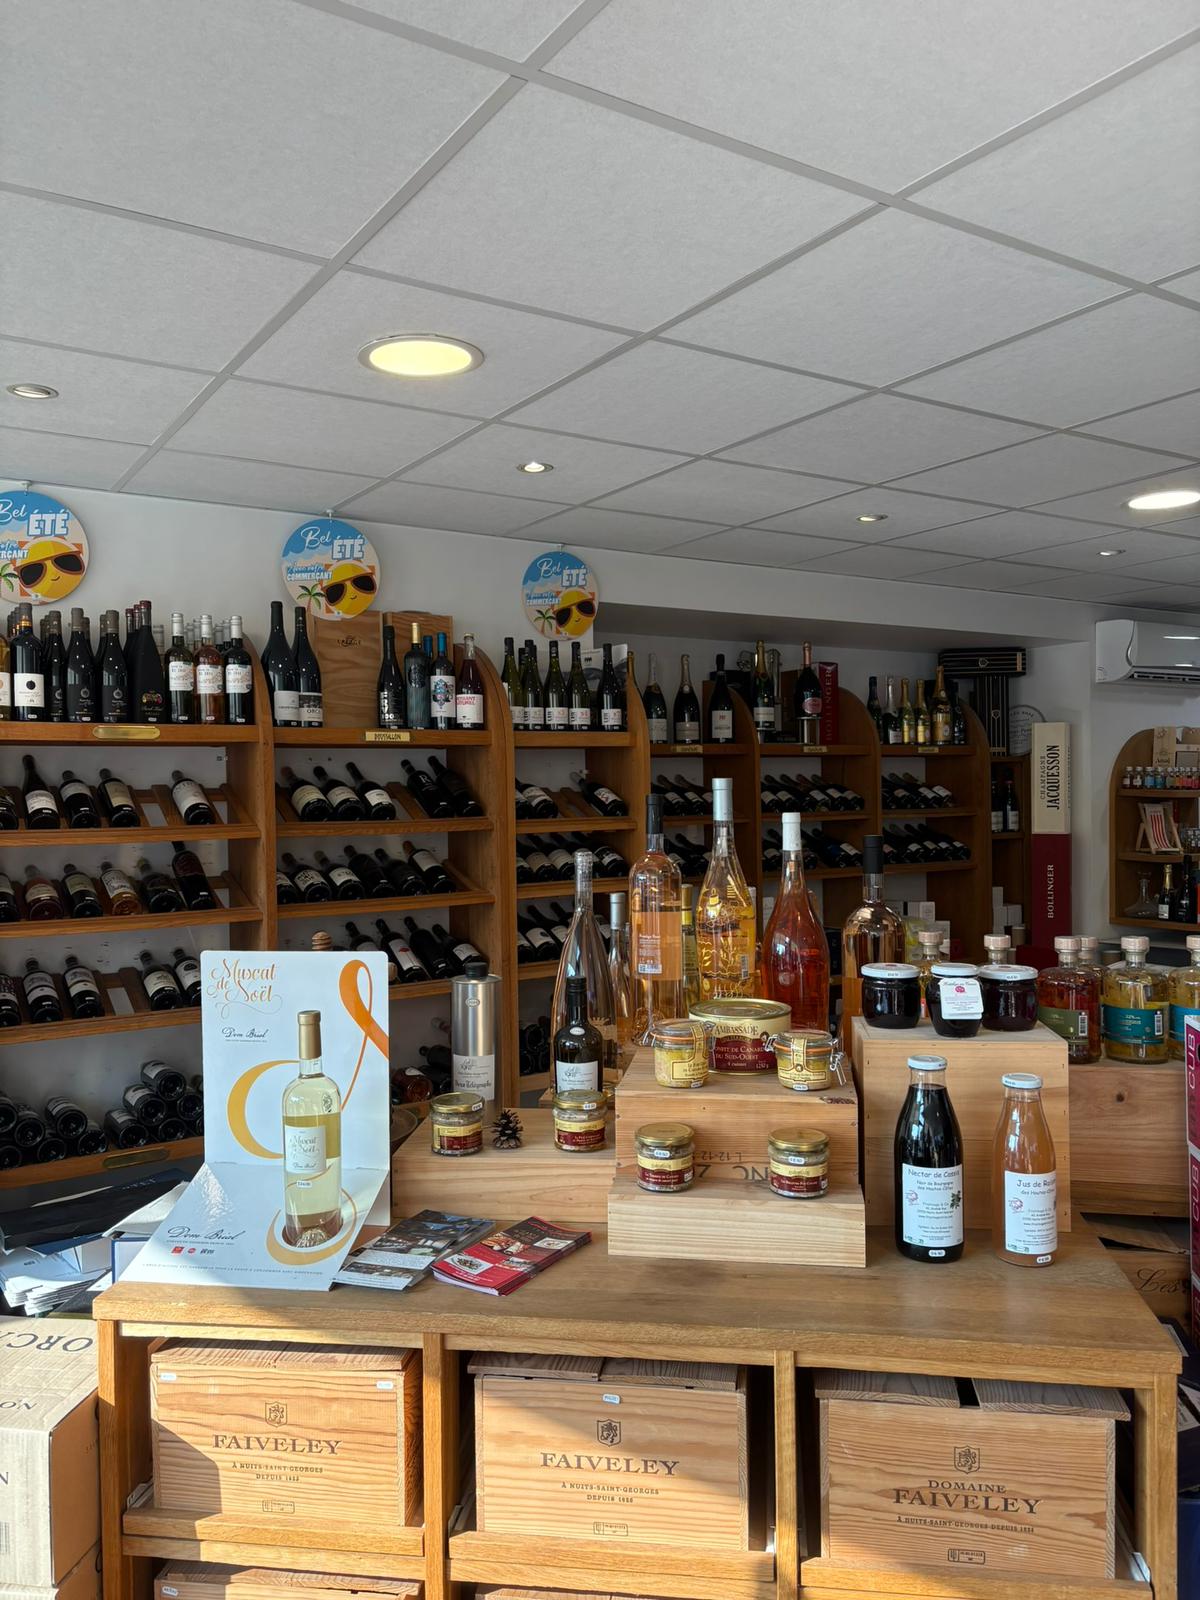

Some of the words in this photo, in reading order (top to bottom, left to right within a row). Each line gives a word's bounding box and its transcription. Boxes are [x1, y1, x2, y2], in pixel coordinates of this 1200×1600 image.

[0, 499, 28, 523] Bel
[28, 509, 69, 536] ÉTÉ
[301, 526, 332, 548] Bel
[332, 534, 365, 560] ÉTÉ
[537, 558, 562, 577] Bel
[561, 565, 587, 588] ÉTÉ
[1046, 745, 1060, 810] JACQUESSON
[1047, 864, 1055, 919] BOLLINGER
[210, 958, 277, 983] Muscat
[216, 977, 230, 990] de
[224, 980, 273, 1003] Noël
[714, 1024, 760, 1036] AMBASSADE
[907, 1168, 932, 1179] Nectar
[933, 1171, 943, 1179] de
[1016, 1179, 1032, 1188] Jus
[1032, 1180, 1042, 1188] de
[167, 1225, 201, 1239] Dom
[212, 1434, 343, 1456] FAIVELEY
[540, 1452, 680, 1476] FAIVELEY
[256, 1473, 282, 1481] DEPUIS
[928, 1479, 1007, 1494] DOMAINE
[569, 1483, 660, 1495] NUITS-SAINT-GEORGES
[586, 1494, 615, 1502] DEPUIS
[892, 1488, 1044, 1514] FAIVELEY
